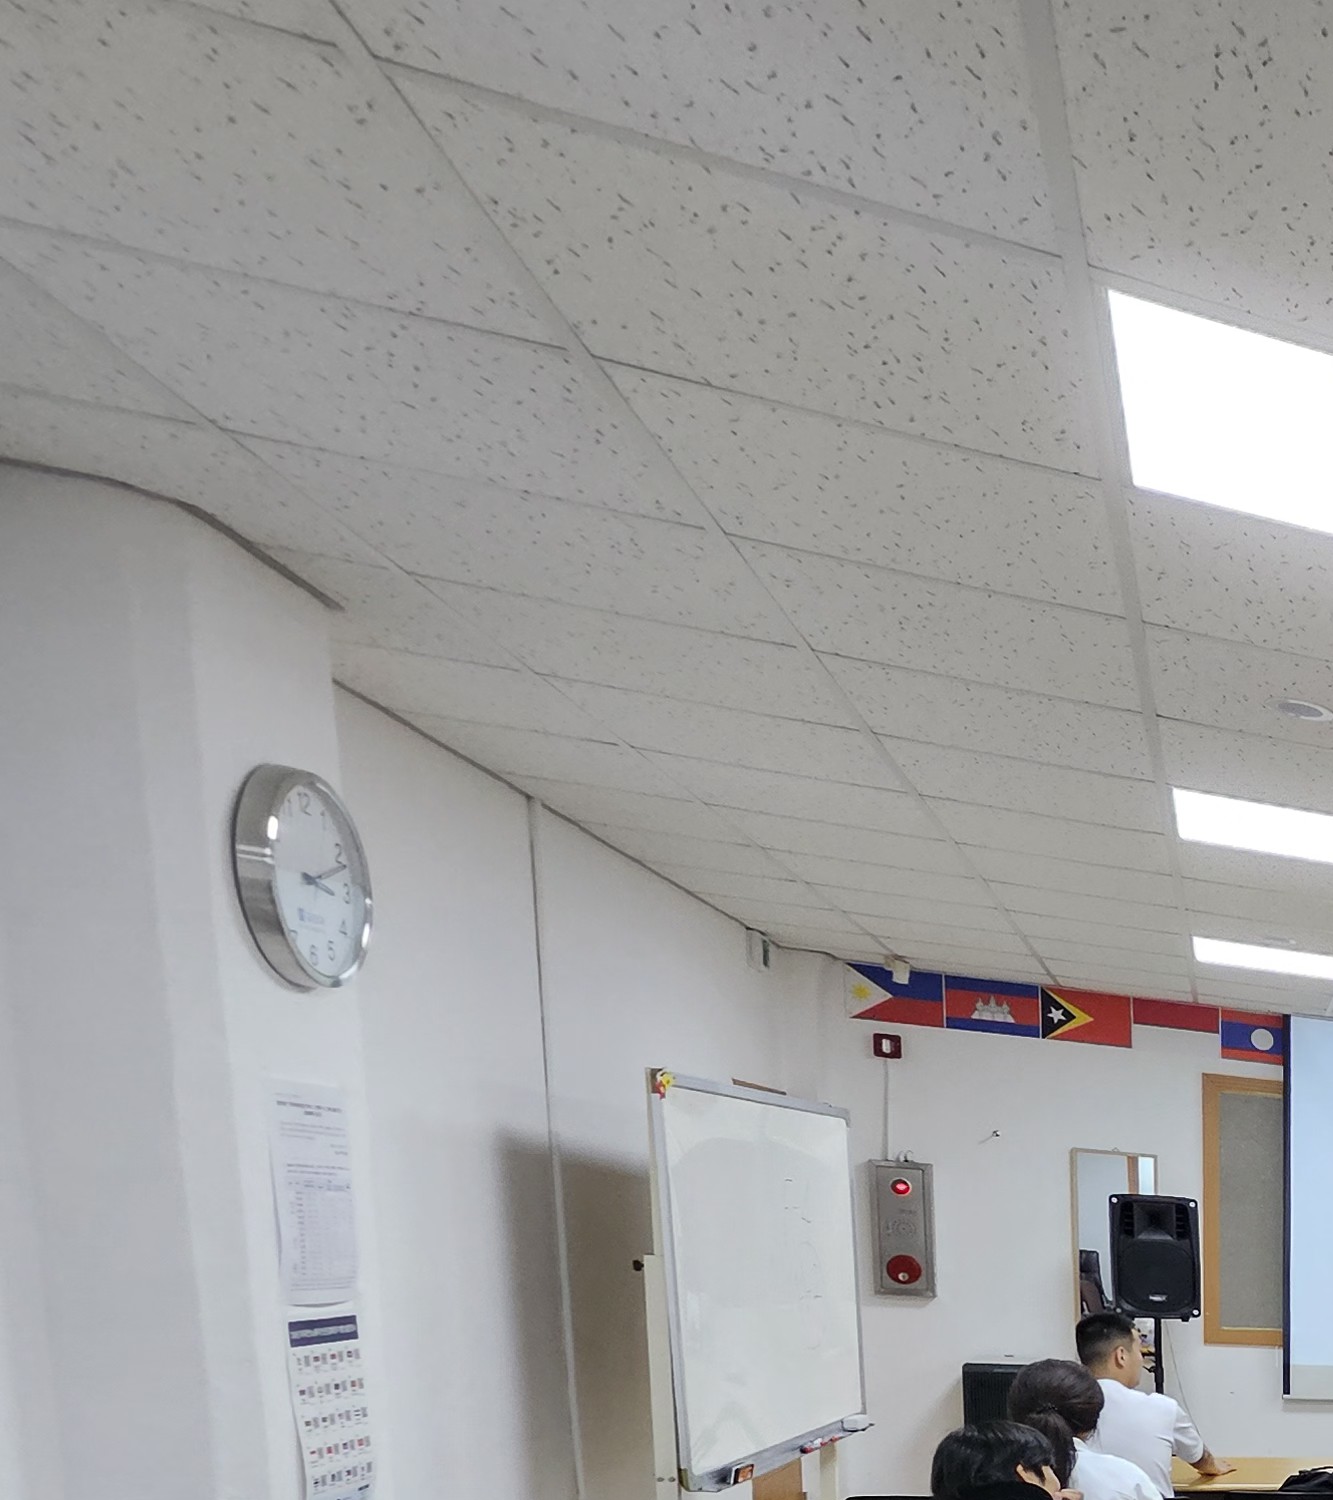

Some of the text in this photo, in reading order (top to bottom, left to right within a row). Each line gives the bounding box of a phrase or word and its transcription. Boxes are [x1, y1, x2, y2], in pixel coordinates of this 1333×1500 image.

[297, 791, 312, 817] 12
[334, 842, 347, 867] 2
[342, 882, 351, 905] 3
[338, 918, 349, 937] 4
